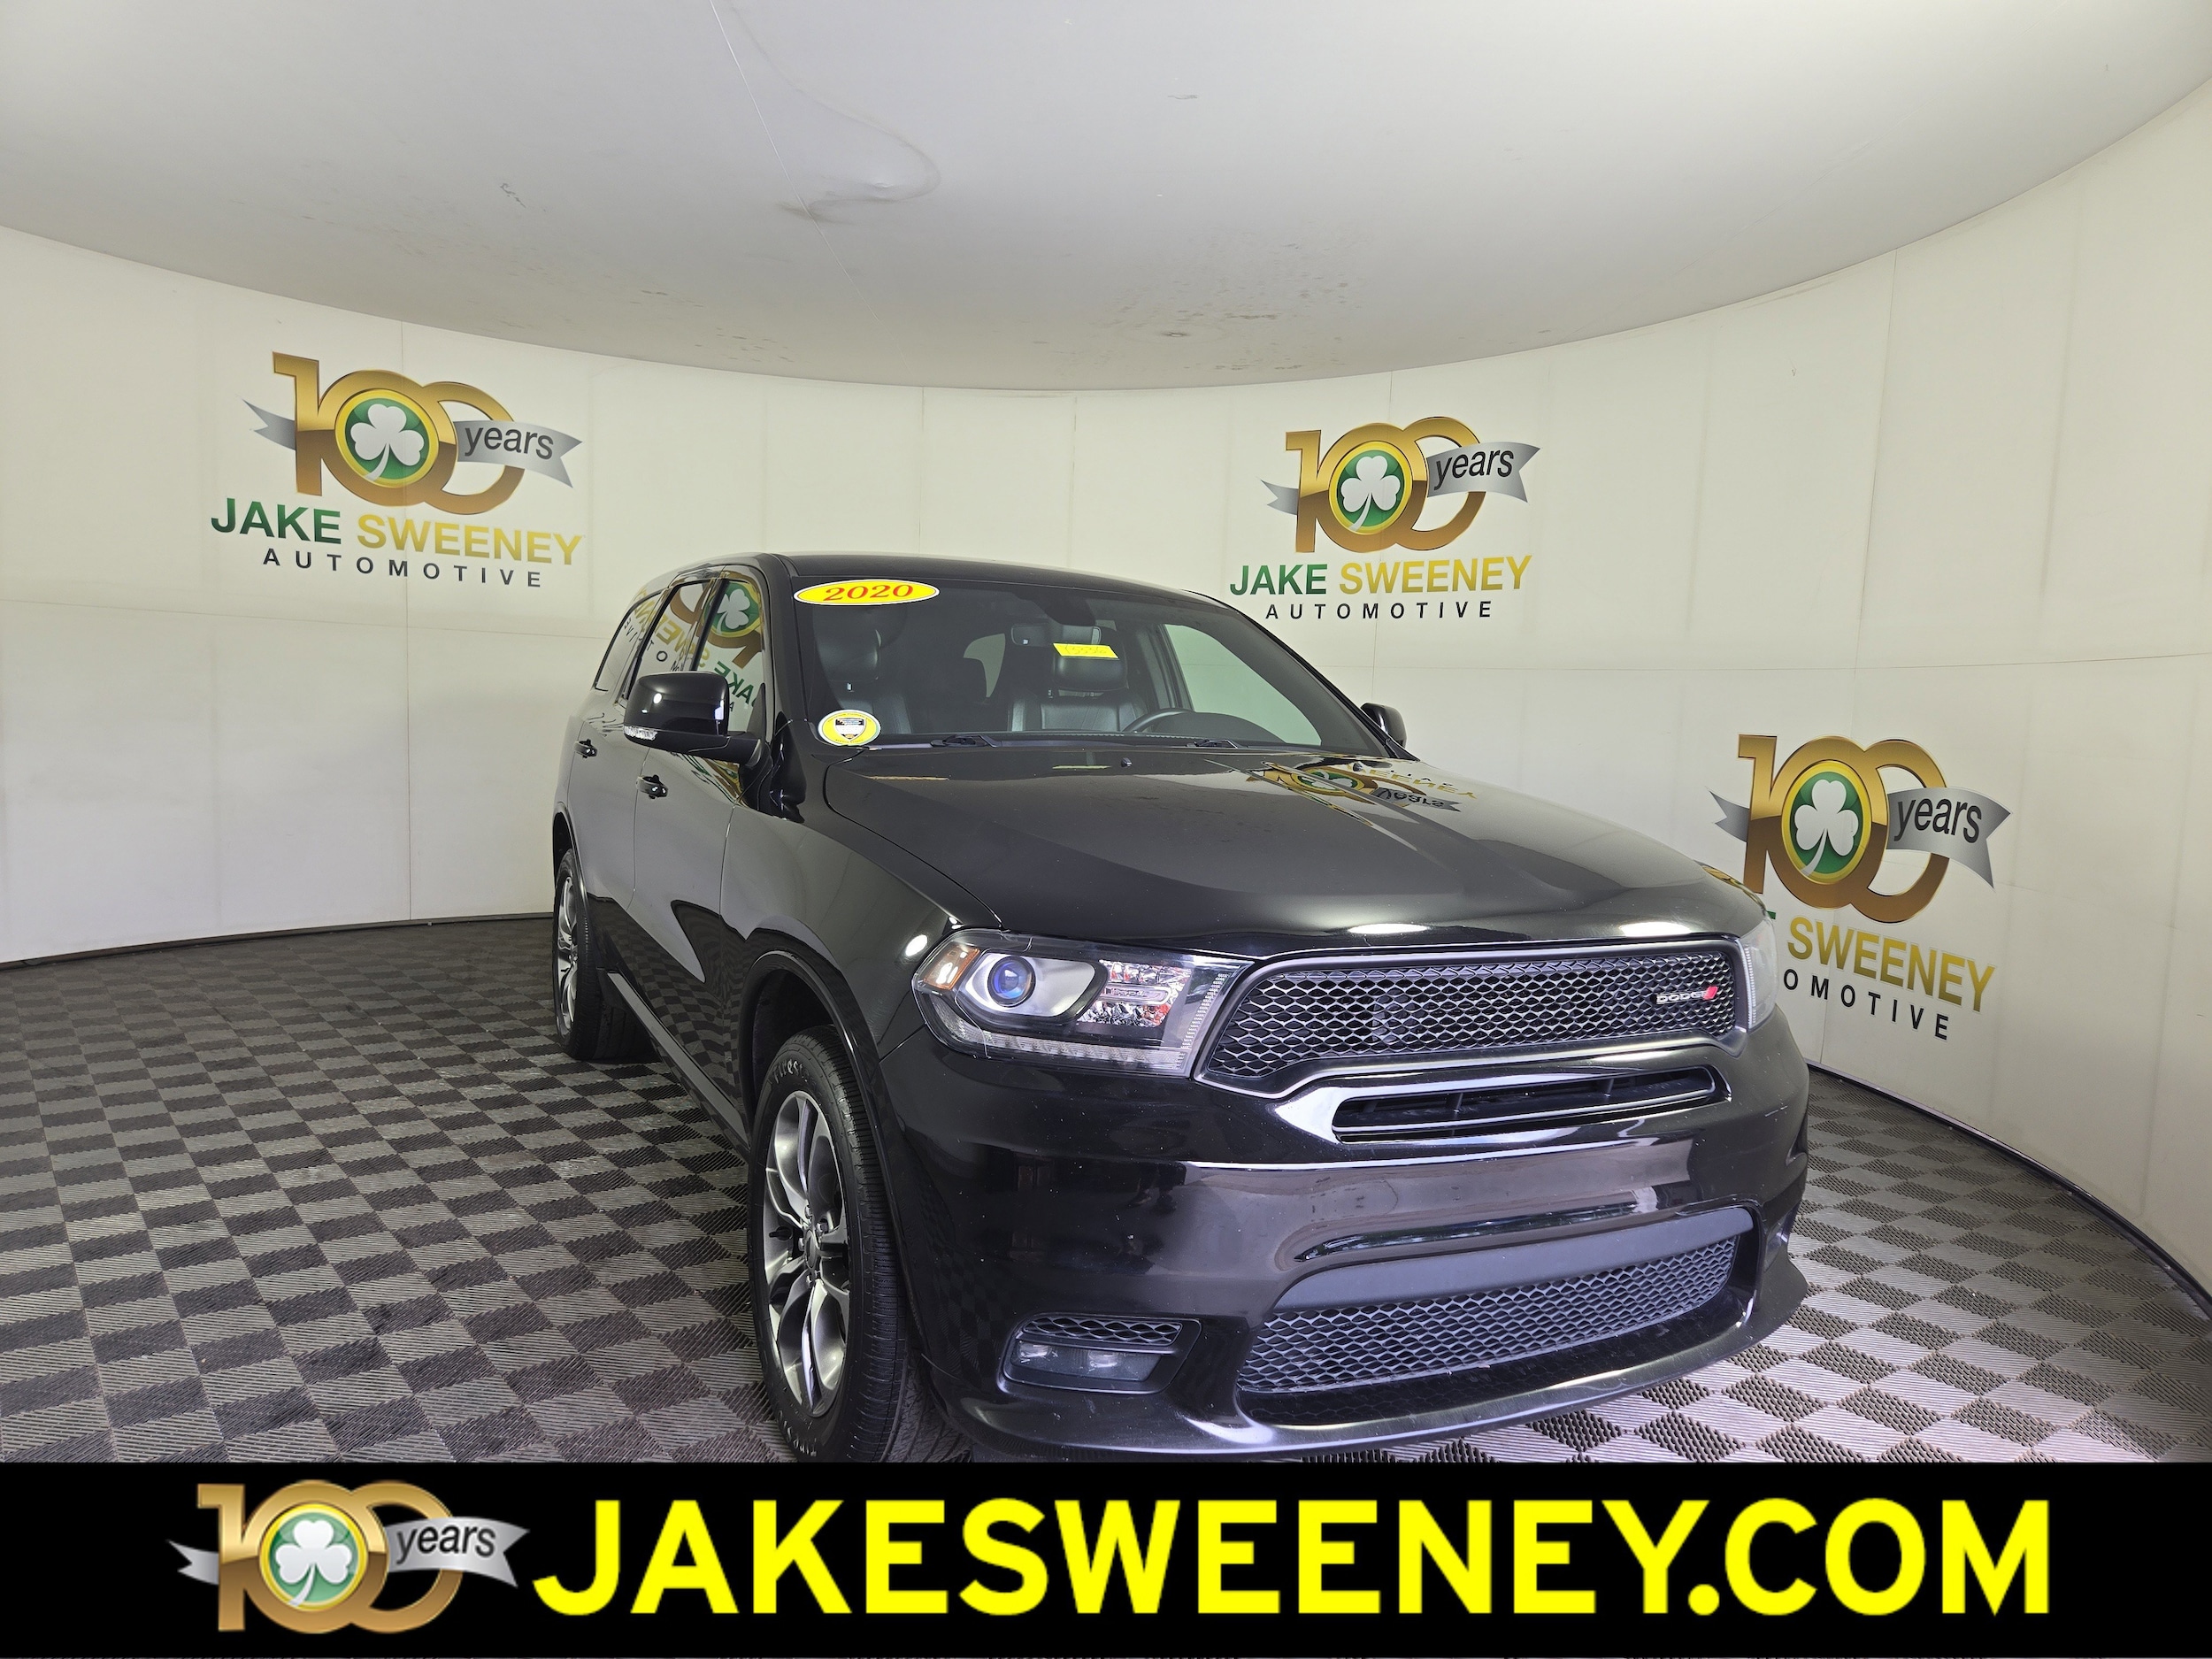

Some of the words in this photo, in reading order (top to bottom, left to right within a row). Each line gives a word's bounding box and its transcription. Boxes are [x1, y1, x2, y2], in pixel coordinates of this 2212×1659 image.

[273, 351, 526, 515] 100
[464, 426, 554, 460] years
[1286, 416, 1486, 553] 100
[1433, 448, 1514, 492] years
[211, 497, 342, 545] JAKE
[357, 514, 582, 565] SWEENEY
[263, 548, 541, 588] AUTOMOTIVE
[823, 584, 914, 601] 2020
[1230, 563, 1328, 595] JAKE
[1340, 555, 1532, 595] SWEENEY
[1265, 601, 1492, 620] AUTOMOTIVE
[1893, 798, 1982, 843] years
[1787, 917, 1996, 1012] SWEENEY
[1783, 968, 1950, 1041] OMOTIVE
